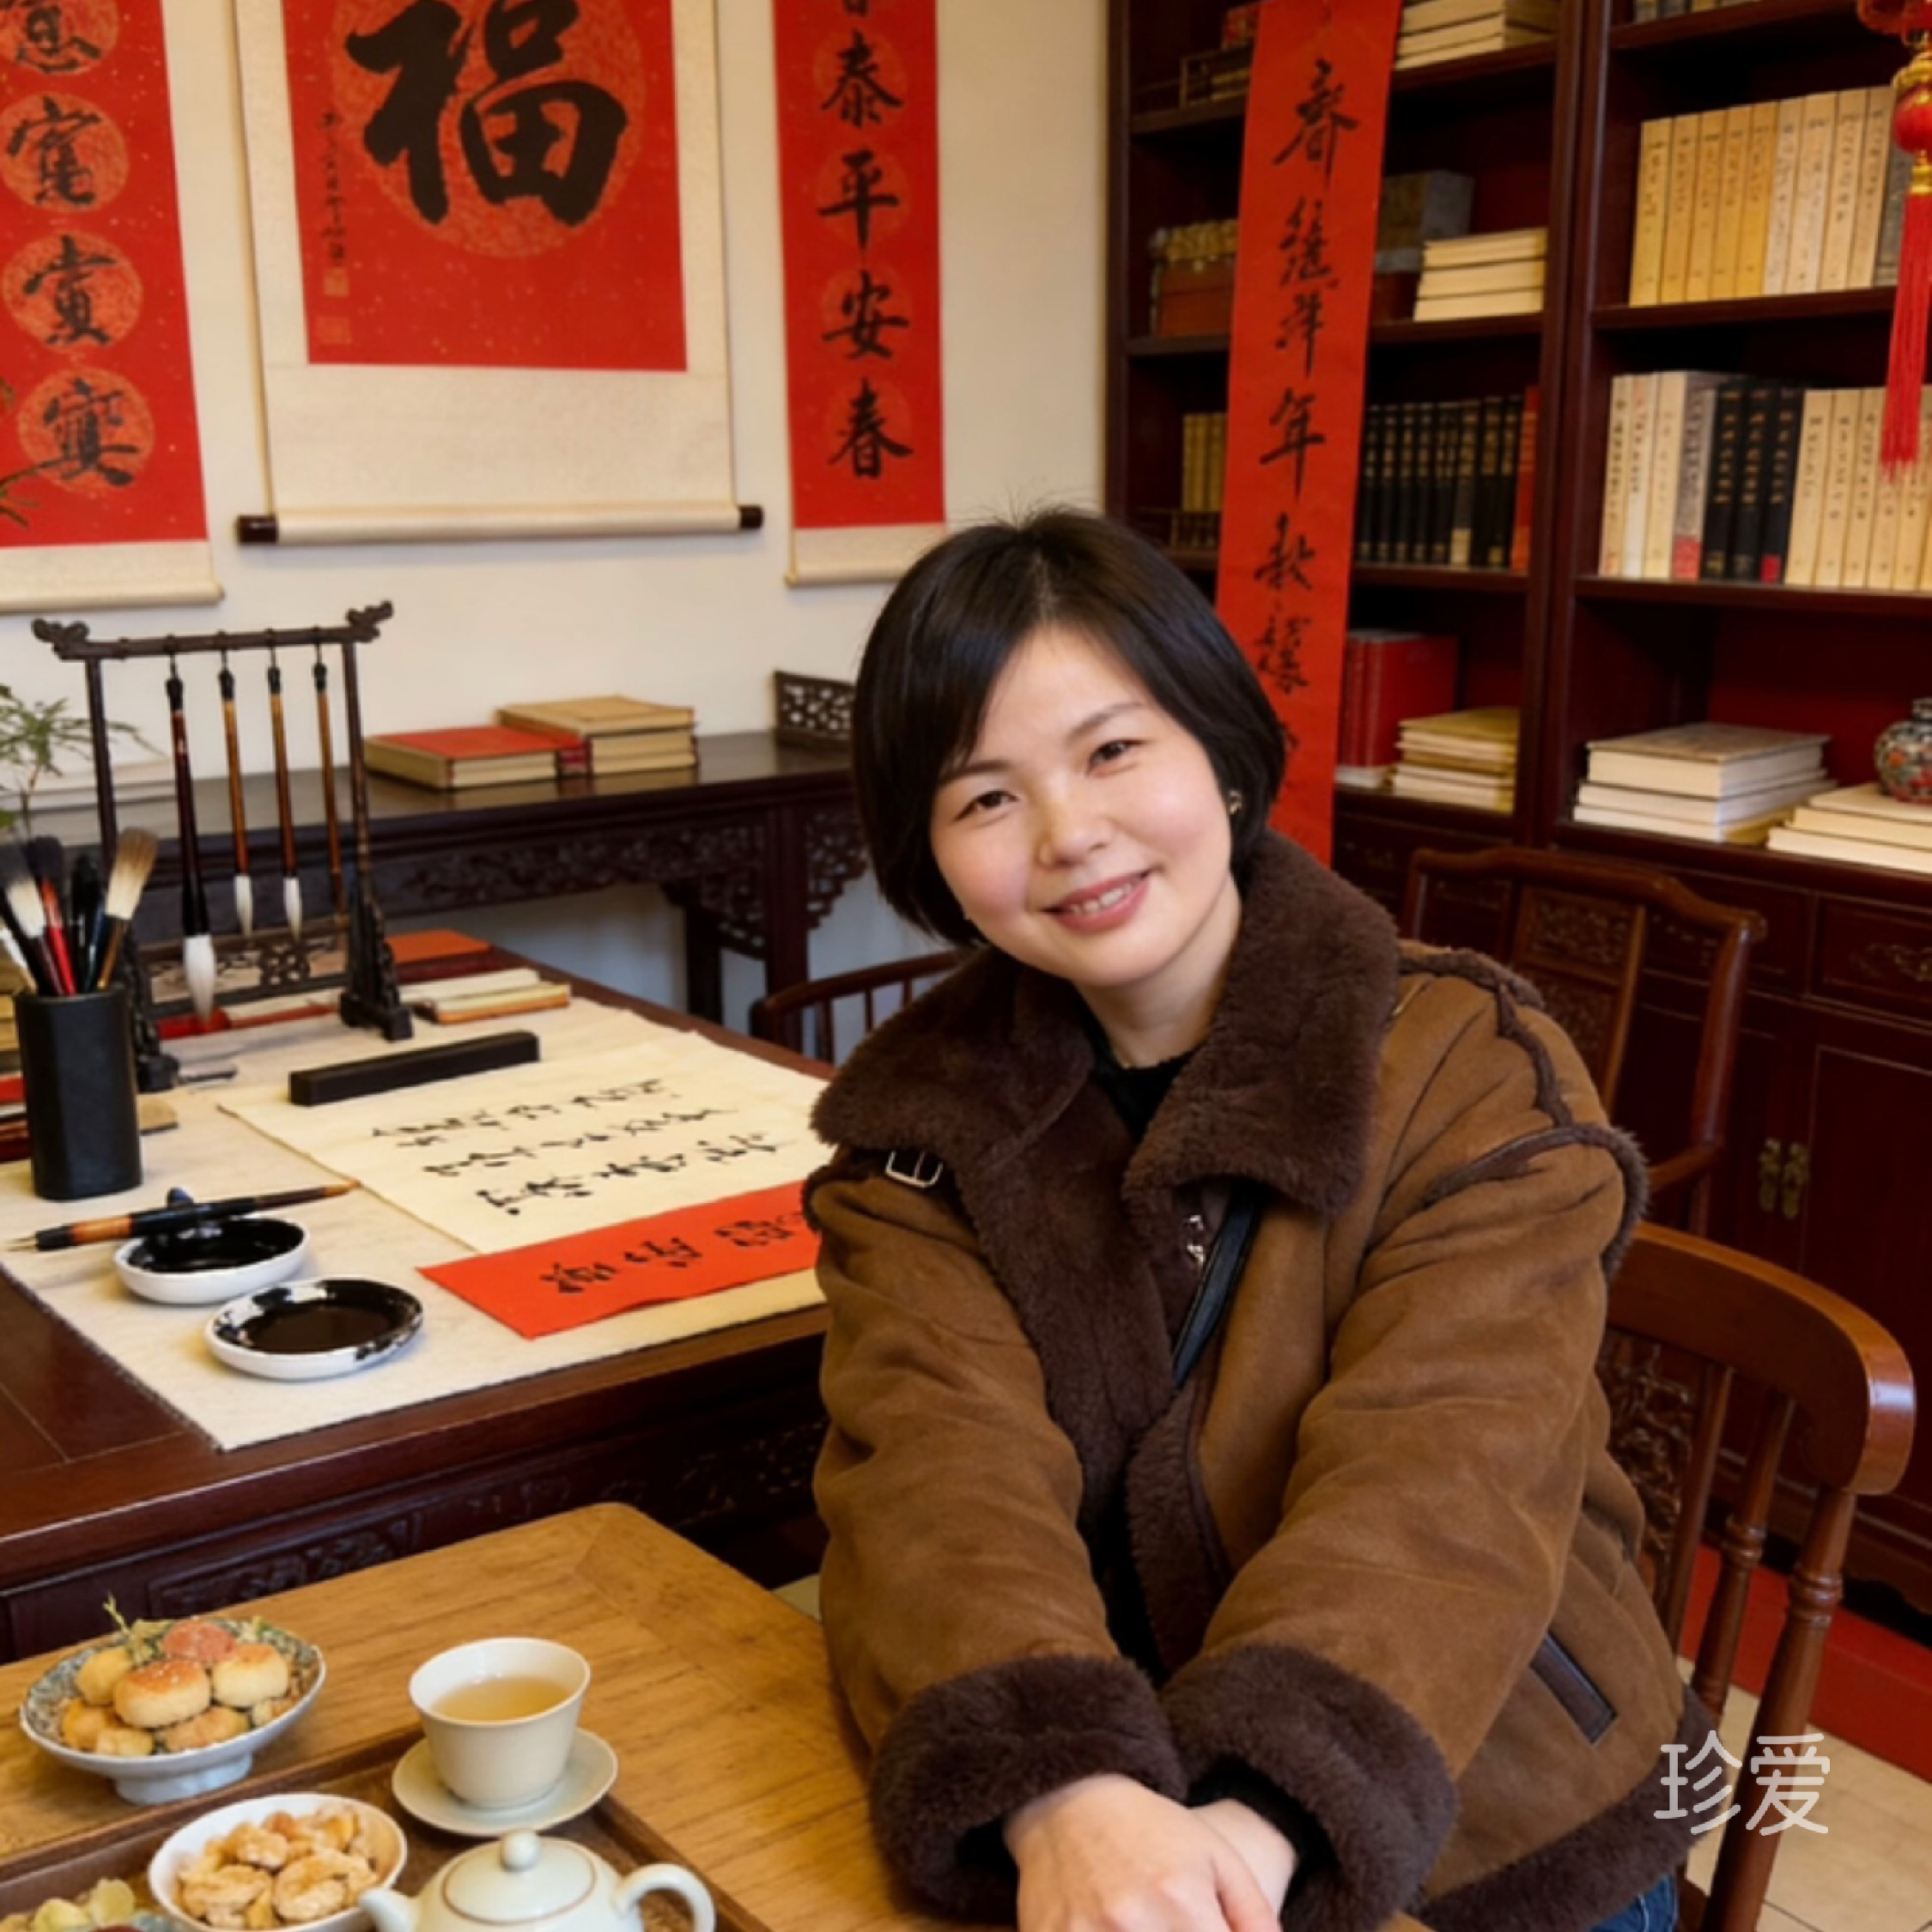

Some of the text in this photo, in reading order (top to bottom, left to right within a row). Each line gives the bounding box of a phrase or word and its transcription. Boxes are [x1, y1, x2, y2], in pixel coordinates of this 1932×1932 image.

[345, 0, 629, 227] 福
[817, 0, 915, 480] 泰平安春
